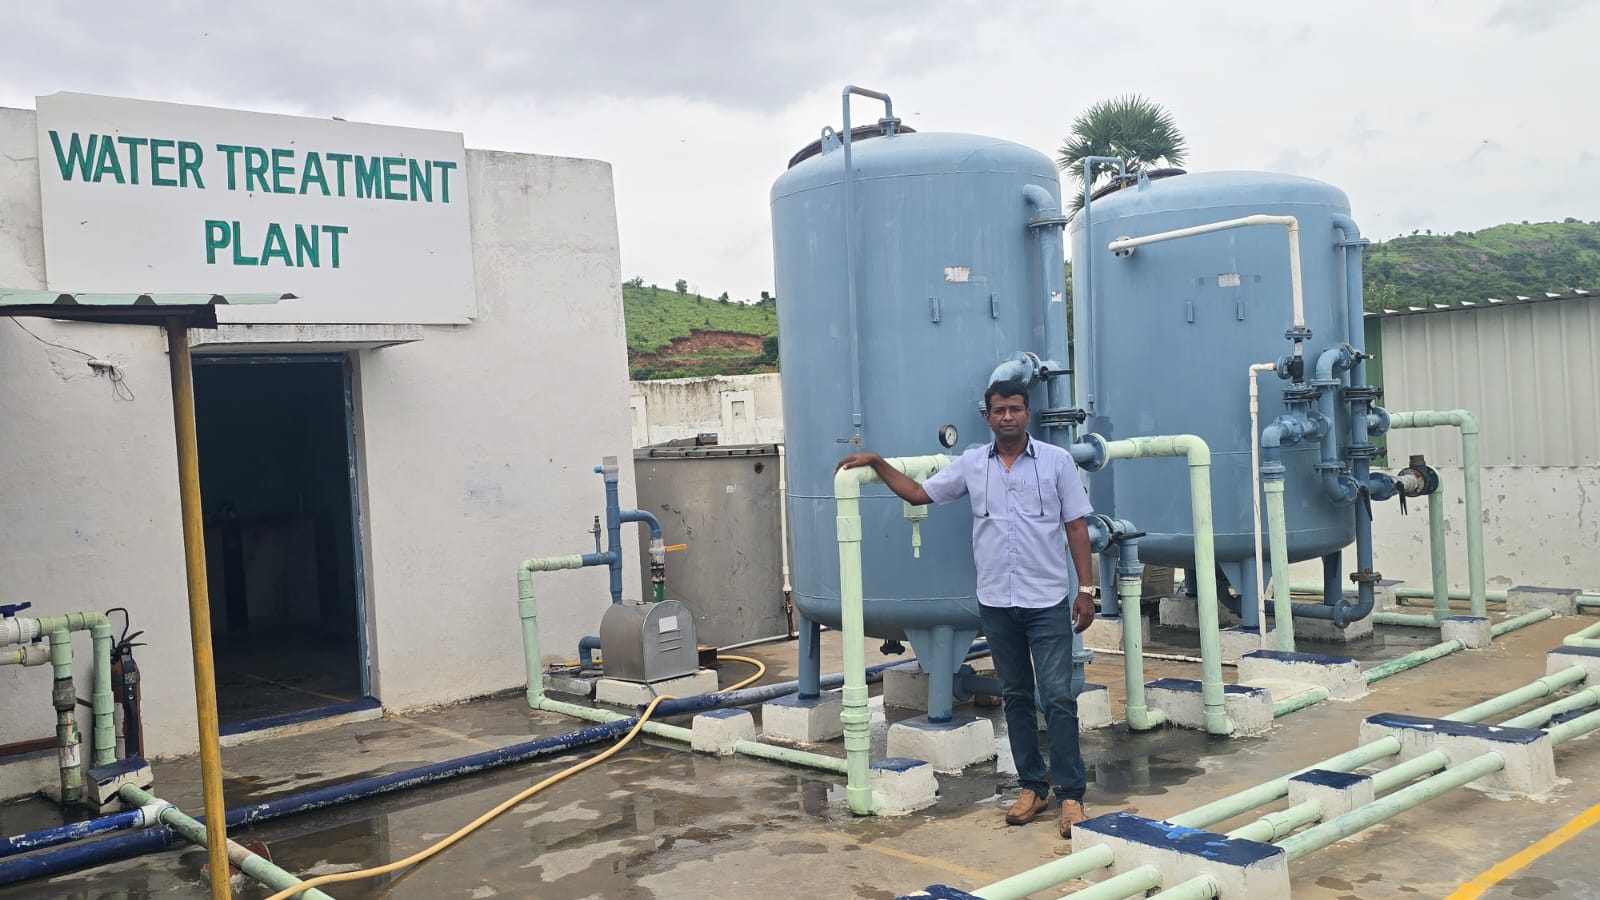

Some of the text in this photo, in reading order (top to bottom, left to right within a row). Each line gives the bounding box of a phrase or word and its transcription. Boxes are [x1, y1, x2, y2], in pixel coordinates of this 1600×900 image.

[48, 130, 457, 204] WATER TREATMENT
[204, 220, 349, 268] PLANT
